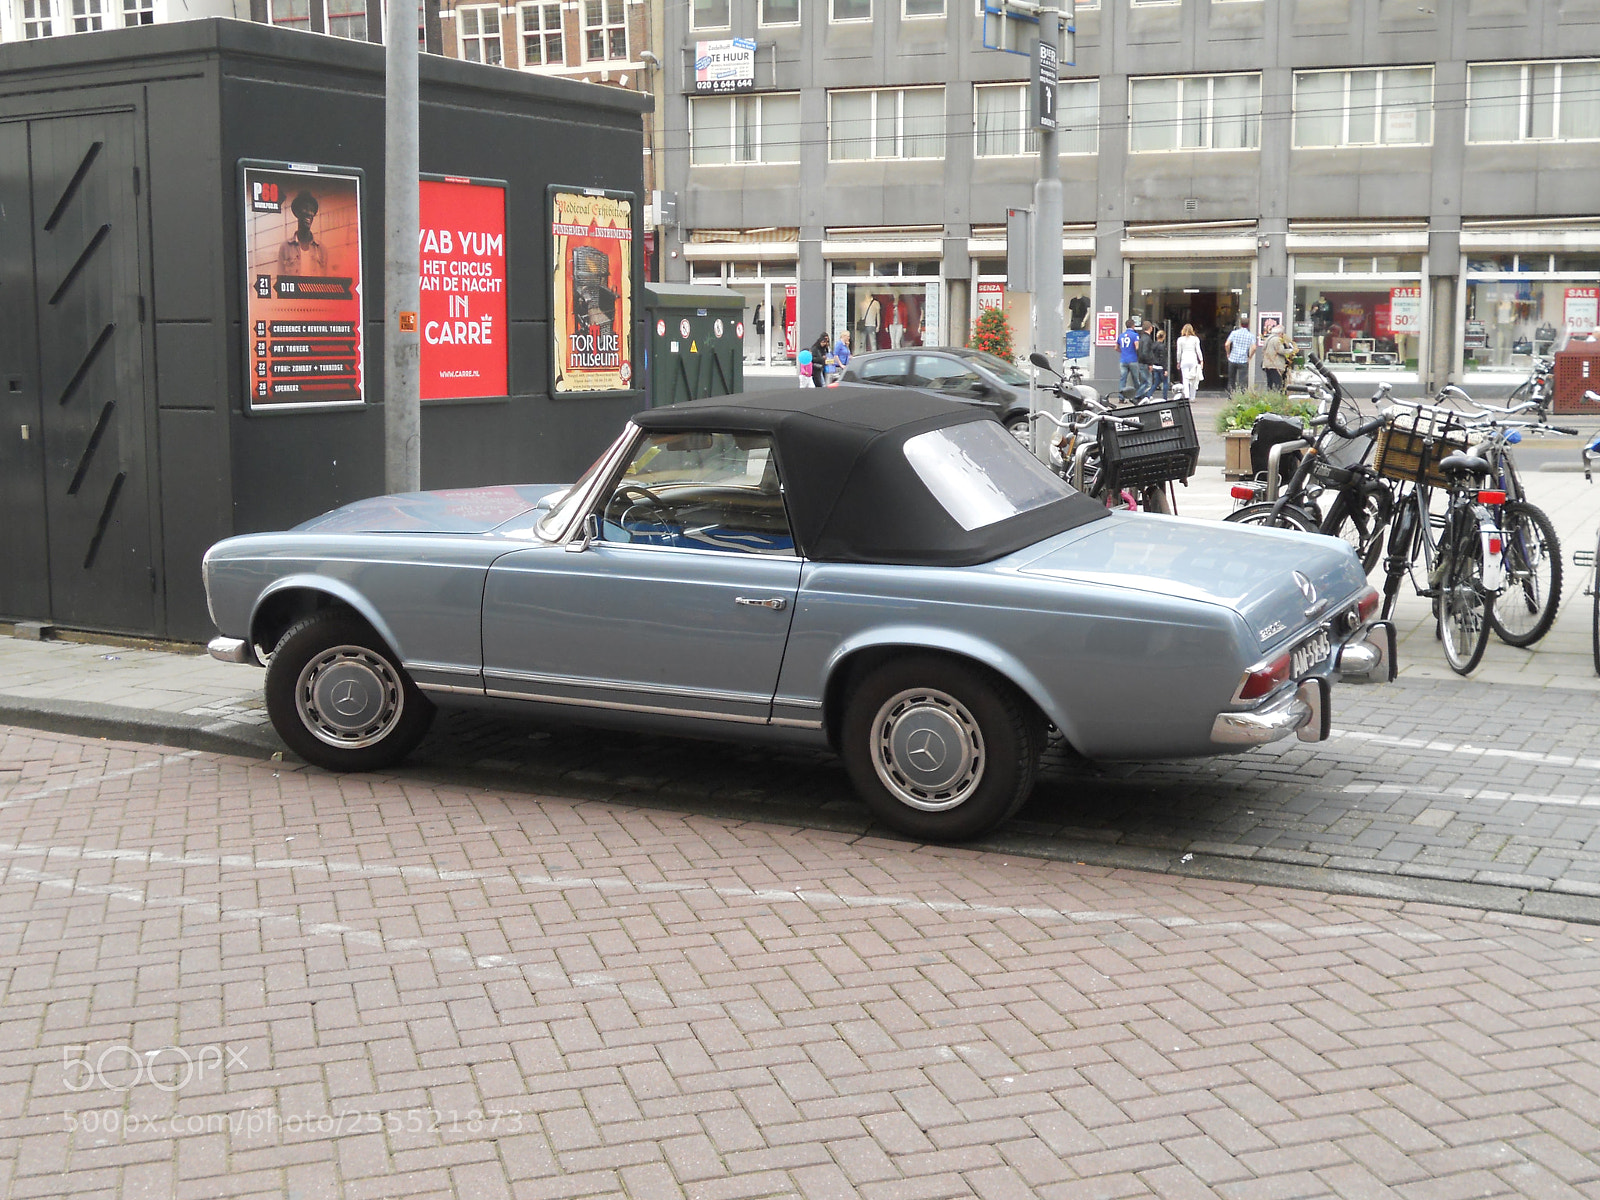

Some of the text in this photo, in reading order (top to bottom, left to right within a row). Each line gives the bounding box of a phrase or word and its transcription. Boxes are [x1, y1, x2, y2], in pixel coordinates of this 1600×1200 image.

[711, 52, 749, 62] TE HUUR
[1040, 46, 1056, 62] BIER
[697, 81, 712, 89] 020
[720, 80, 735, 88] 644
[737, 79, 752, 87] 644
[253, 182, 279, 202] P60
[553, 223, 589, 237] PUNISHMENT
[595, 227, 632, 240] INSTRUMENTS
[457, 230, 503, 257] YUM
[423, 260, 492, 277] HET CIRCUS
[260, 278, 268, 288] 21
[443, 277, 458, 291] DE
[462, 278, 502, 292] NACHT
[978, 284, 1001, 292] SENZA
[1393, 288, 1420, 297] SALE
[1568, 289, 1595, 297] SALE
[449, 294, 469, 318] IN
[1394, 315, 1418, 325] 50%
[1568, 316, 1594, 328] 50%
[1120, 336, 1131, 348] 19
[570, 352, 619, 367] museum
